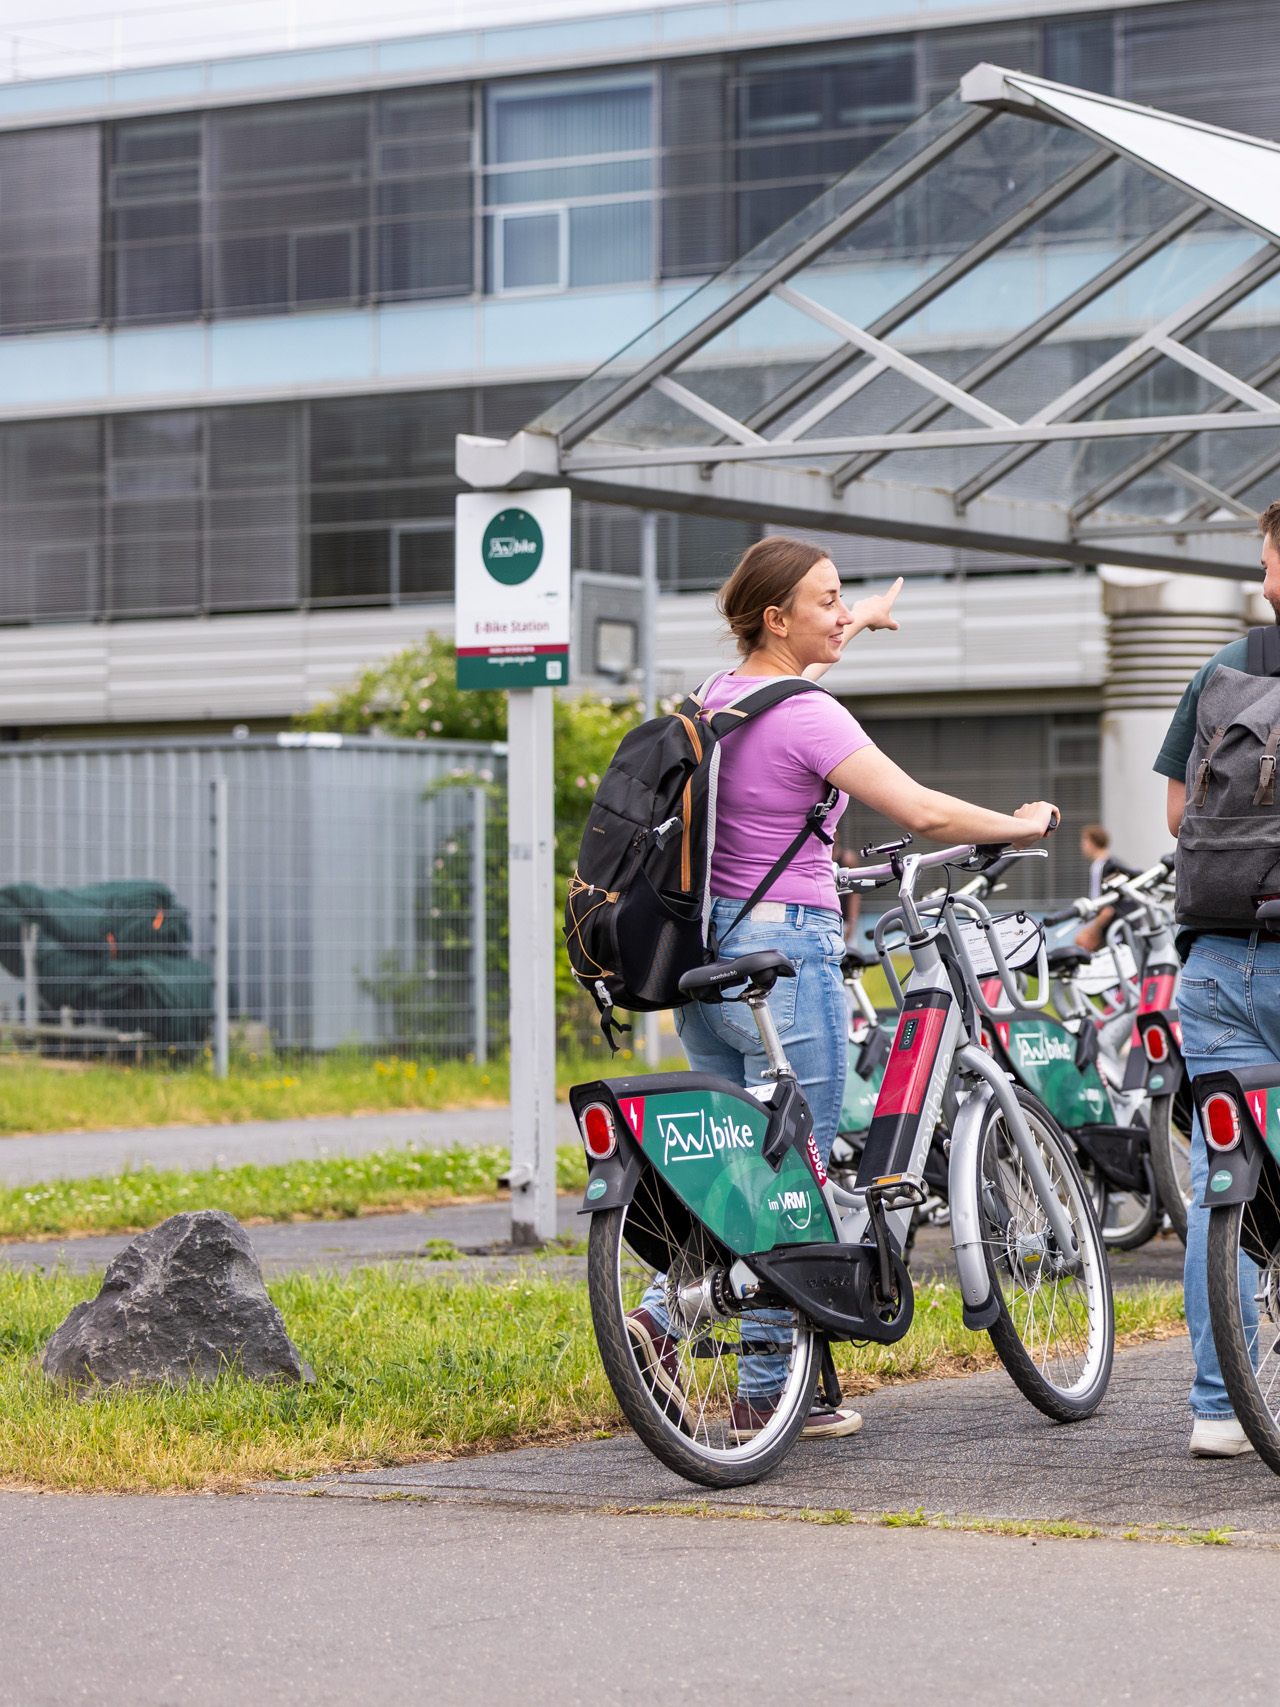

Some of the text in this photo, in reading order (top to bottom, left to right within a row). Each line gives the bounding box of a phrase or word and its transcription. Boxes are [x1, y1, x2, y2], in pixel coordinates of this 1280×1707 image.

[475, 620, 550, 634] E-Bike Station
[1045, 1036, 1072, 1060] bike
[709, 1115, 754, 1149] bike
[767, 1190, 807, 1210] im VRM
